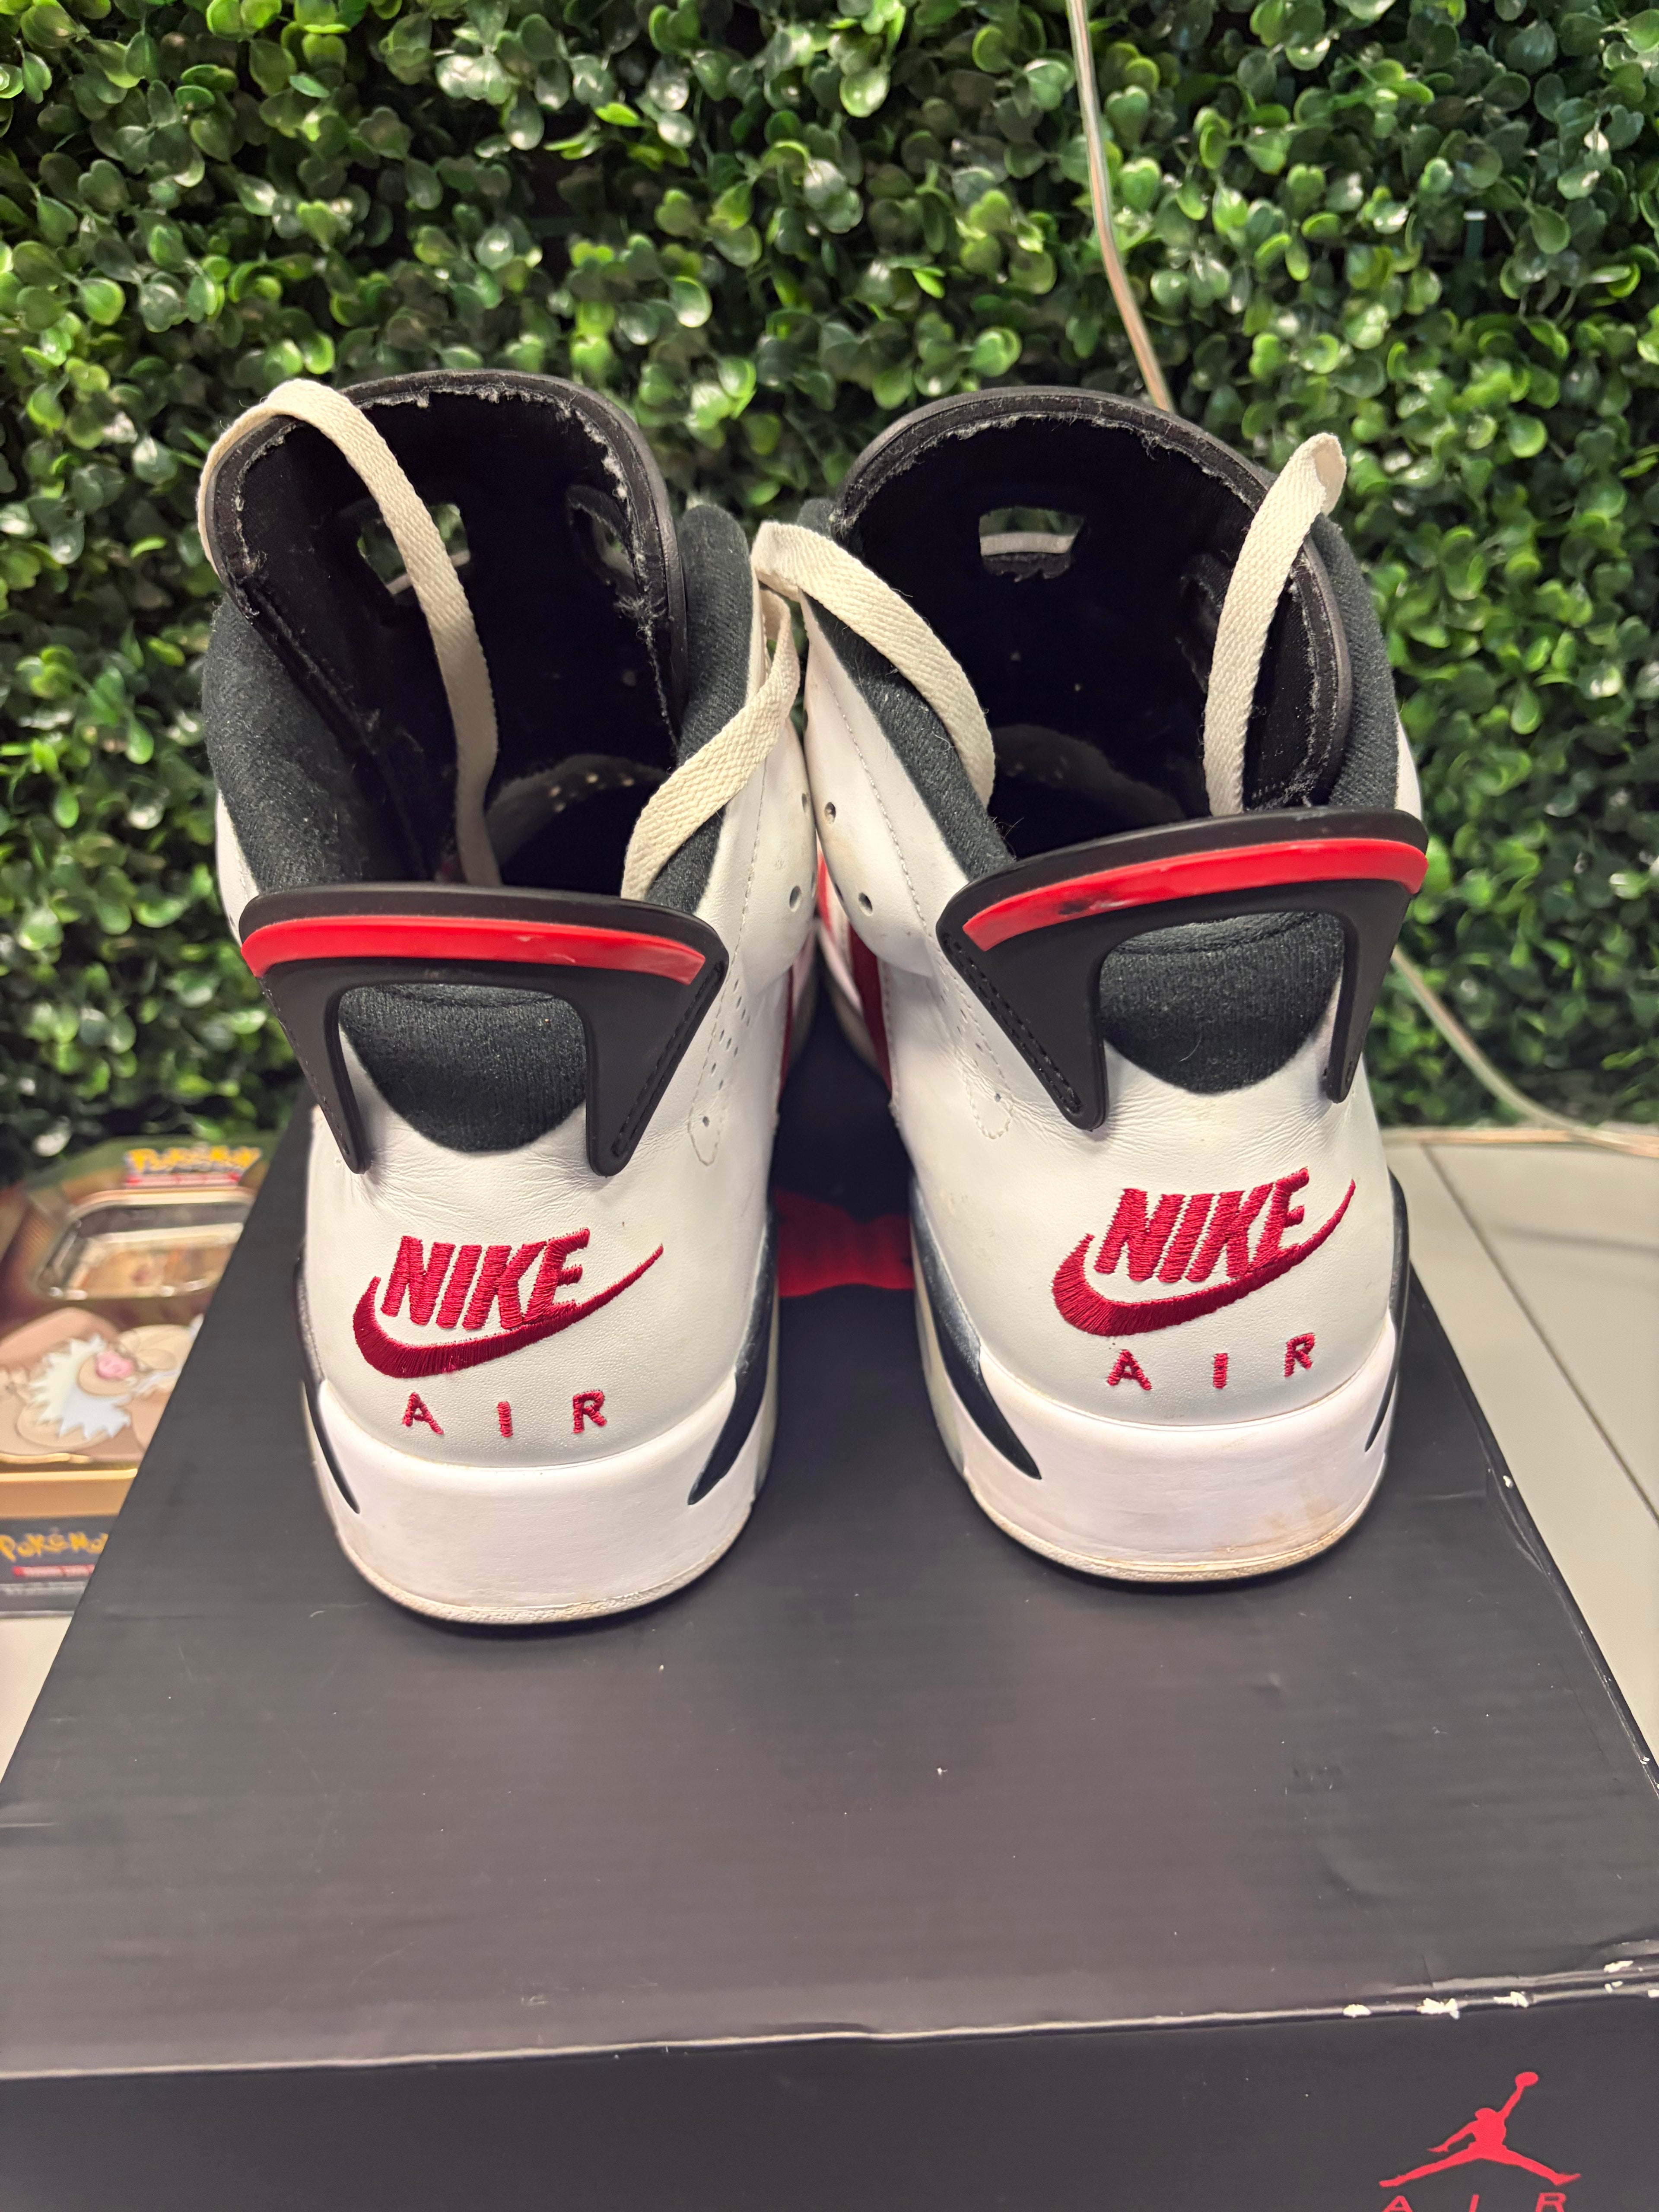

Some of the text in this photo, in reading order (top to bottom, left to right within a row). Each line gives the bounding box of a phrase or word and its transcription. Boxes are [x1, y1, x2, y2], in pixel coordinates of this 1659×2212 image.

[1094, 1167, 1309, 1283] NIKE
[380, 1227, 591, 1330] NIKE
[1107, 1332, 1316, 1390] AIR
[402, 1389, 607, 1437] AIR
